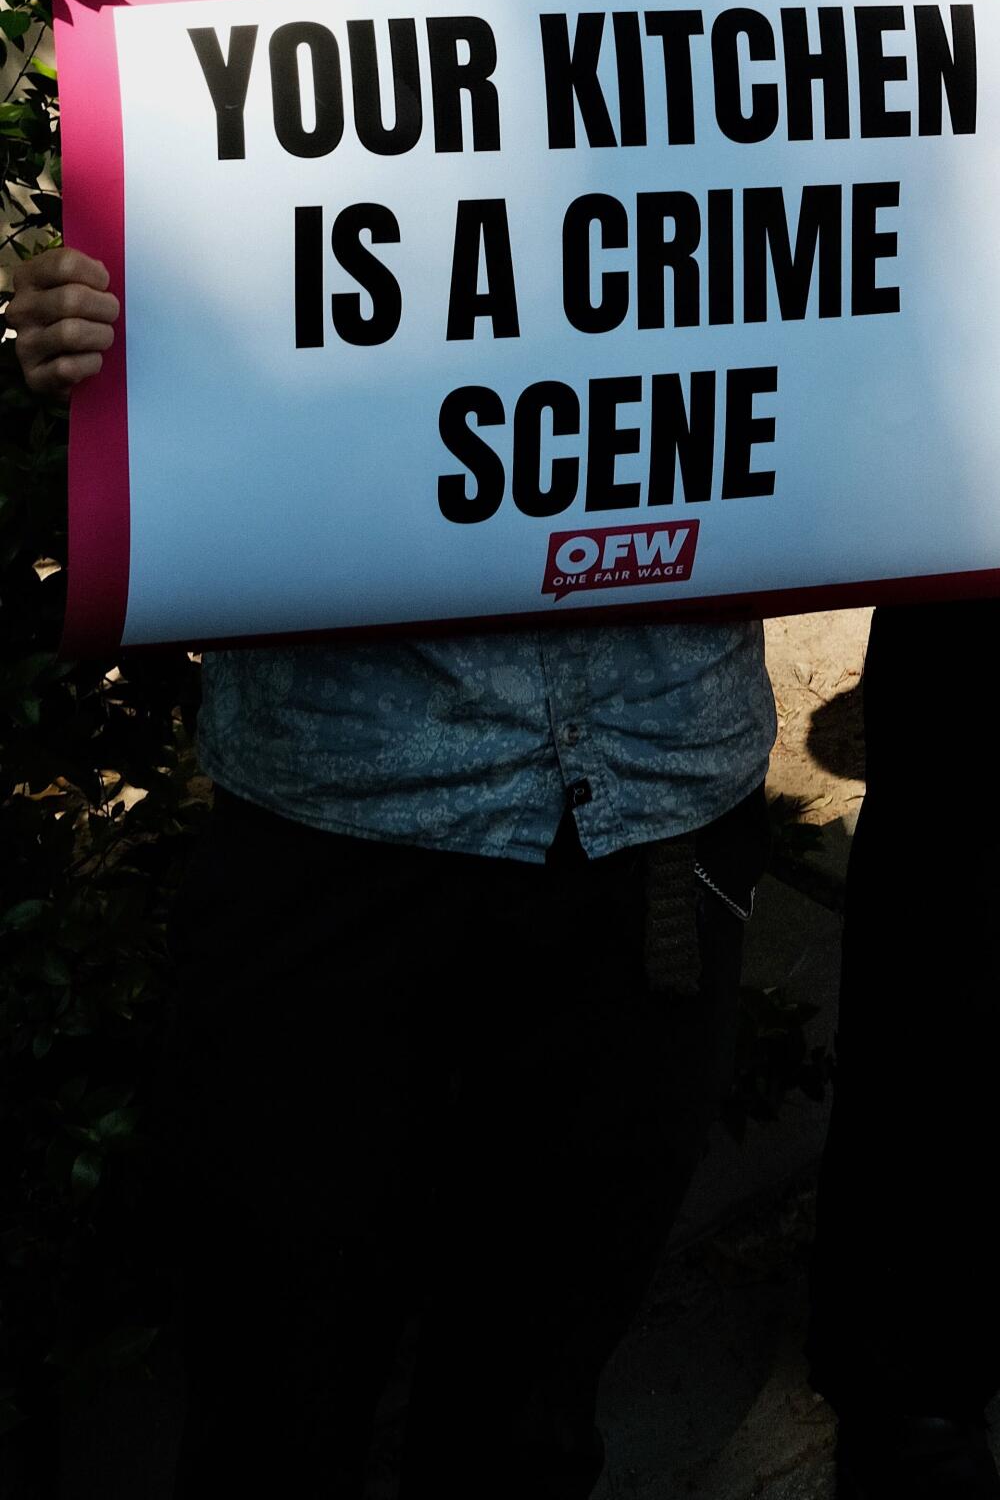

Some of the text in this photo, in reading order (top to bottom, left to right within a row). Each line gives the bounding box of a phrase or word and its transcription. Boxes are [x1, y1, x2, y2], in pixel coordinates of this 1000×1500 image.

[188, 5, 977, 160] YOUR KITCHEN
[295, 182, 900, 348] IS A CRIME
[438, 367, 778, 524] SCENE
[553, 565, 684, 586] ONE FAIR WAGE
[555, 528, 690, 575] OFW
